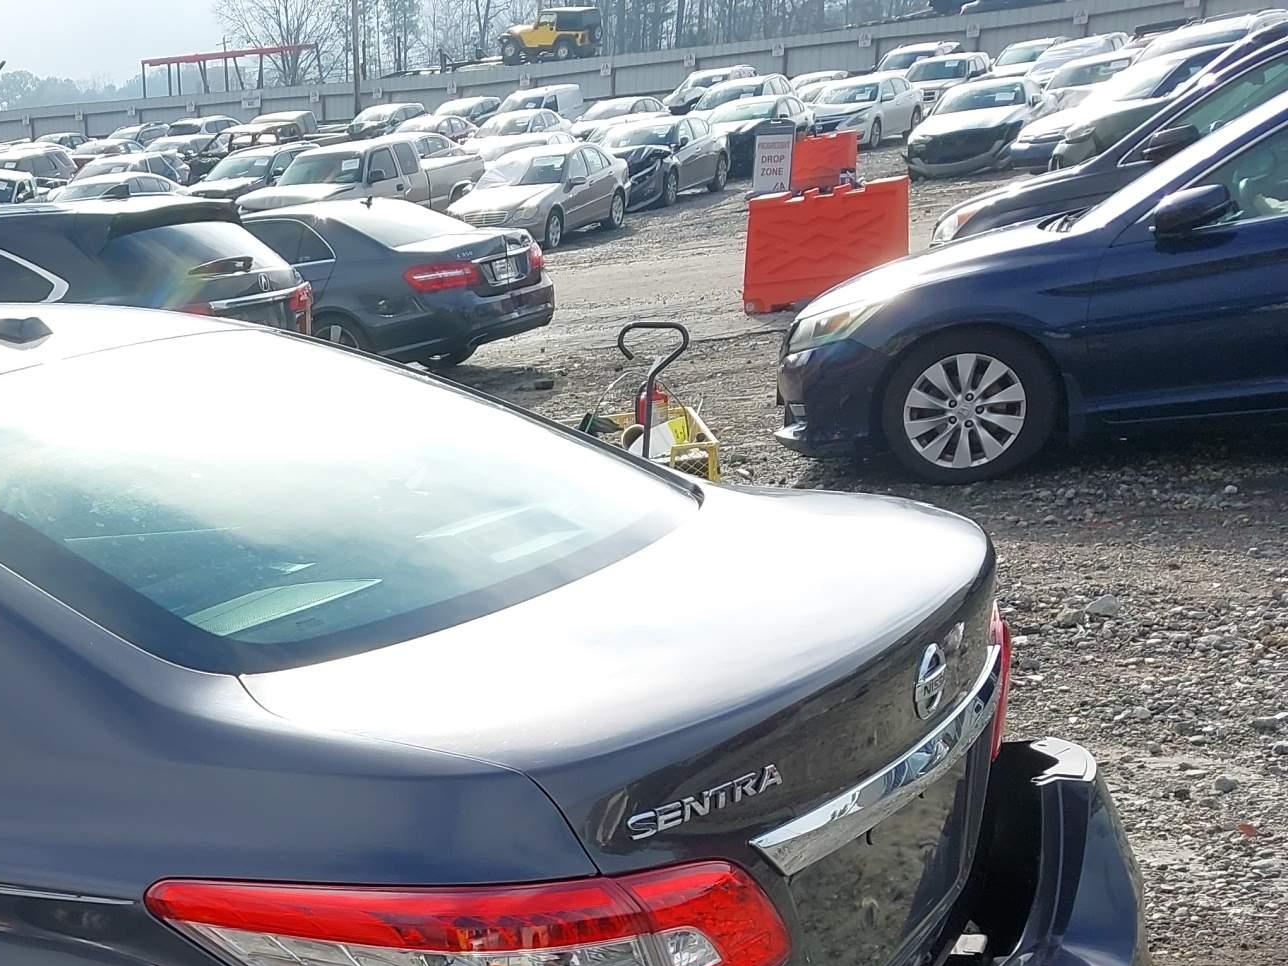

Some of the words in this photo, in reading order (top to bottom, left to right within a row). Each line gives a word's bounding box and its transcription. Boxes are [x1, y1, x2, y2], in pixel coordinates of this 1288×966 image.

[761, 154, 785, 163] DROP
[760, 167, 784, 176] ZONE
[626, 763, 784, 841] SENTRA
